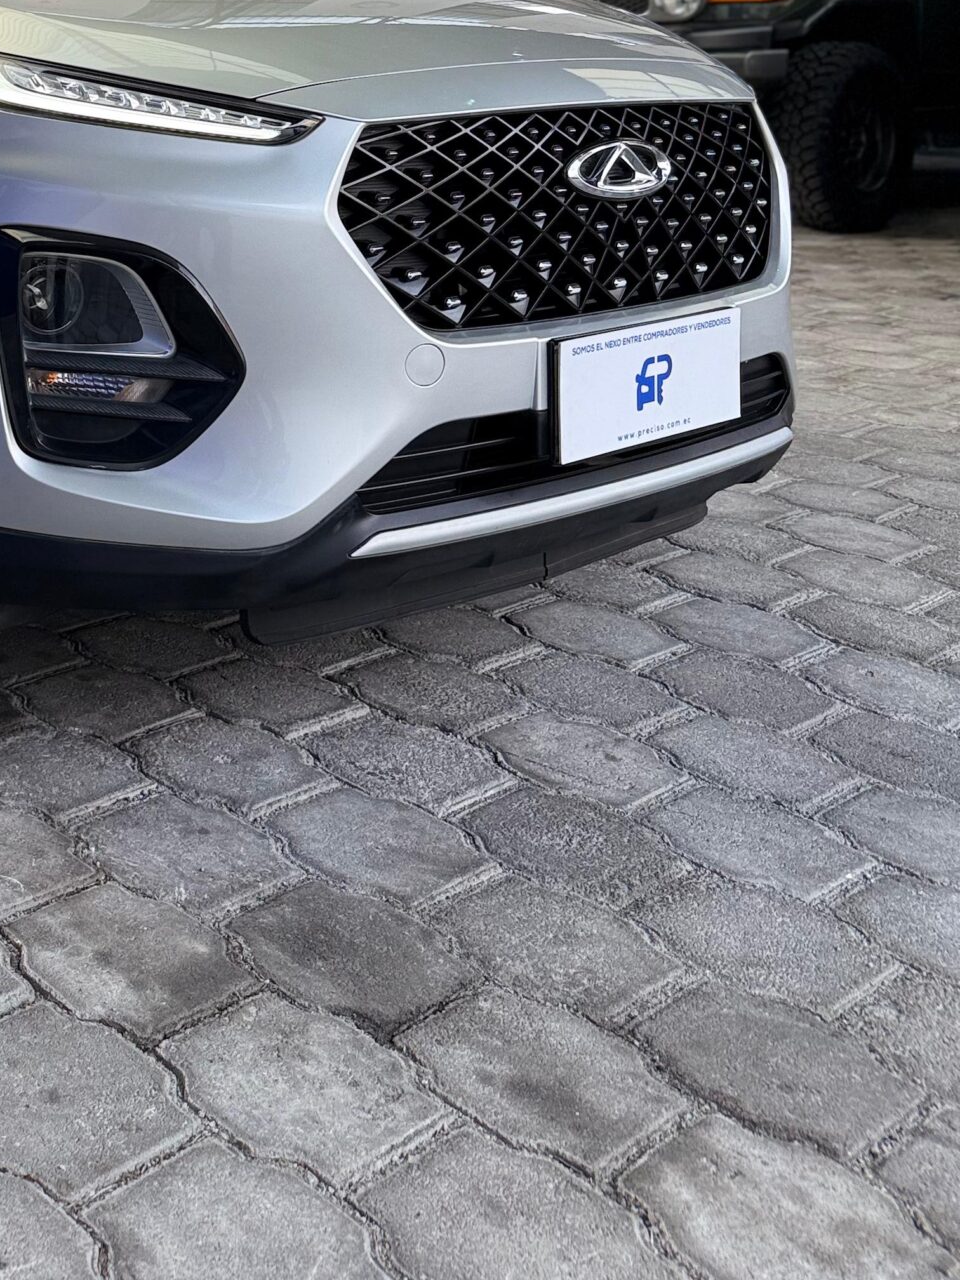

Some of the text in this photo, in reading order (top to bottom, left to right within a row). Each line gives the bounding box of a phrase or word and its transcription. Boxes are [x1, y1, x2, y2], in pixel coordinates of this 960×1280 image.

[572, 343, 595, 356] SOMOS
[596, 342, 604, 351] EL
[605, 338, 621, 349] NEXO
[622, 334, 642, 346] ENTRE
[643, 325, 688, 341] COMPRADORES
[694, 316, 731, 331] VENDEDORES
